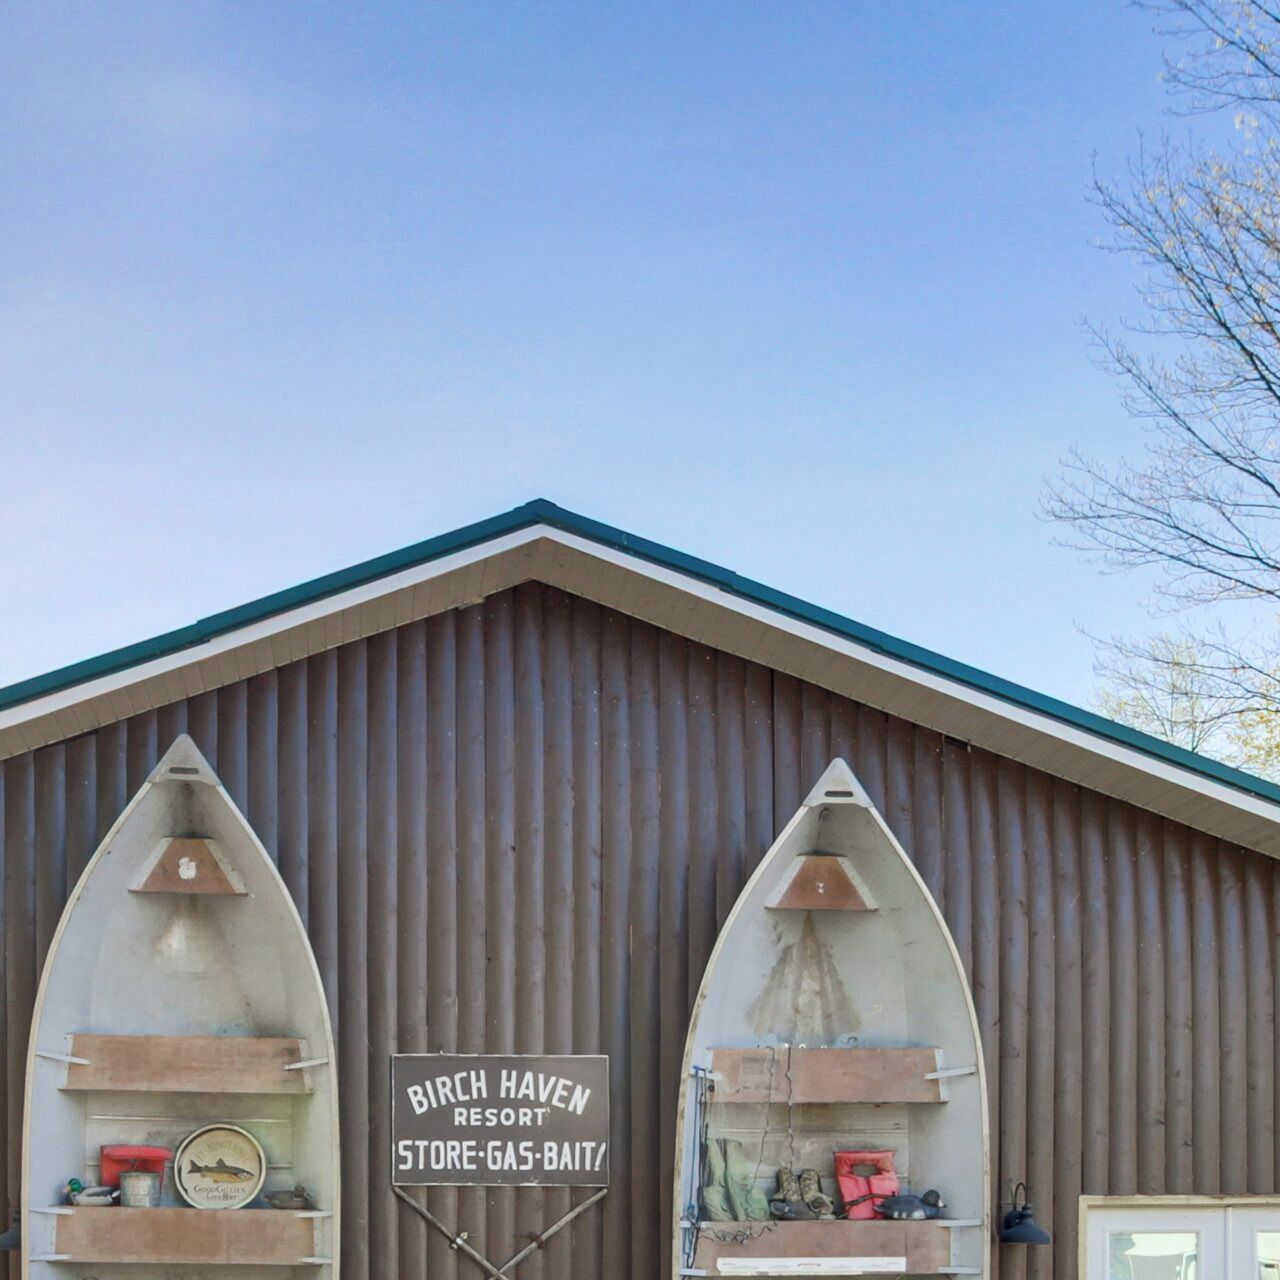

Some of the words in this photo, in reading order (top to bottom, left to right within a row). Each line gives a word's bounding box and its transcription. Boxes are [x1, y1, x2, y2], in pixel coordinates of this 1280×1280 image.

[406, 1069, 488, 1115] BIRCH
[499, 1069, 591, 1115] HAVEN
[453, 1107, 547, 1127] RESORT
